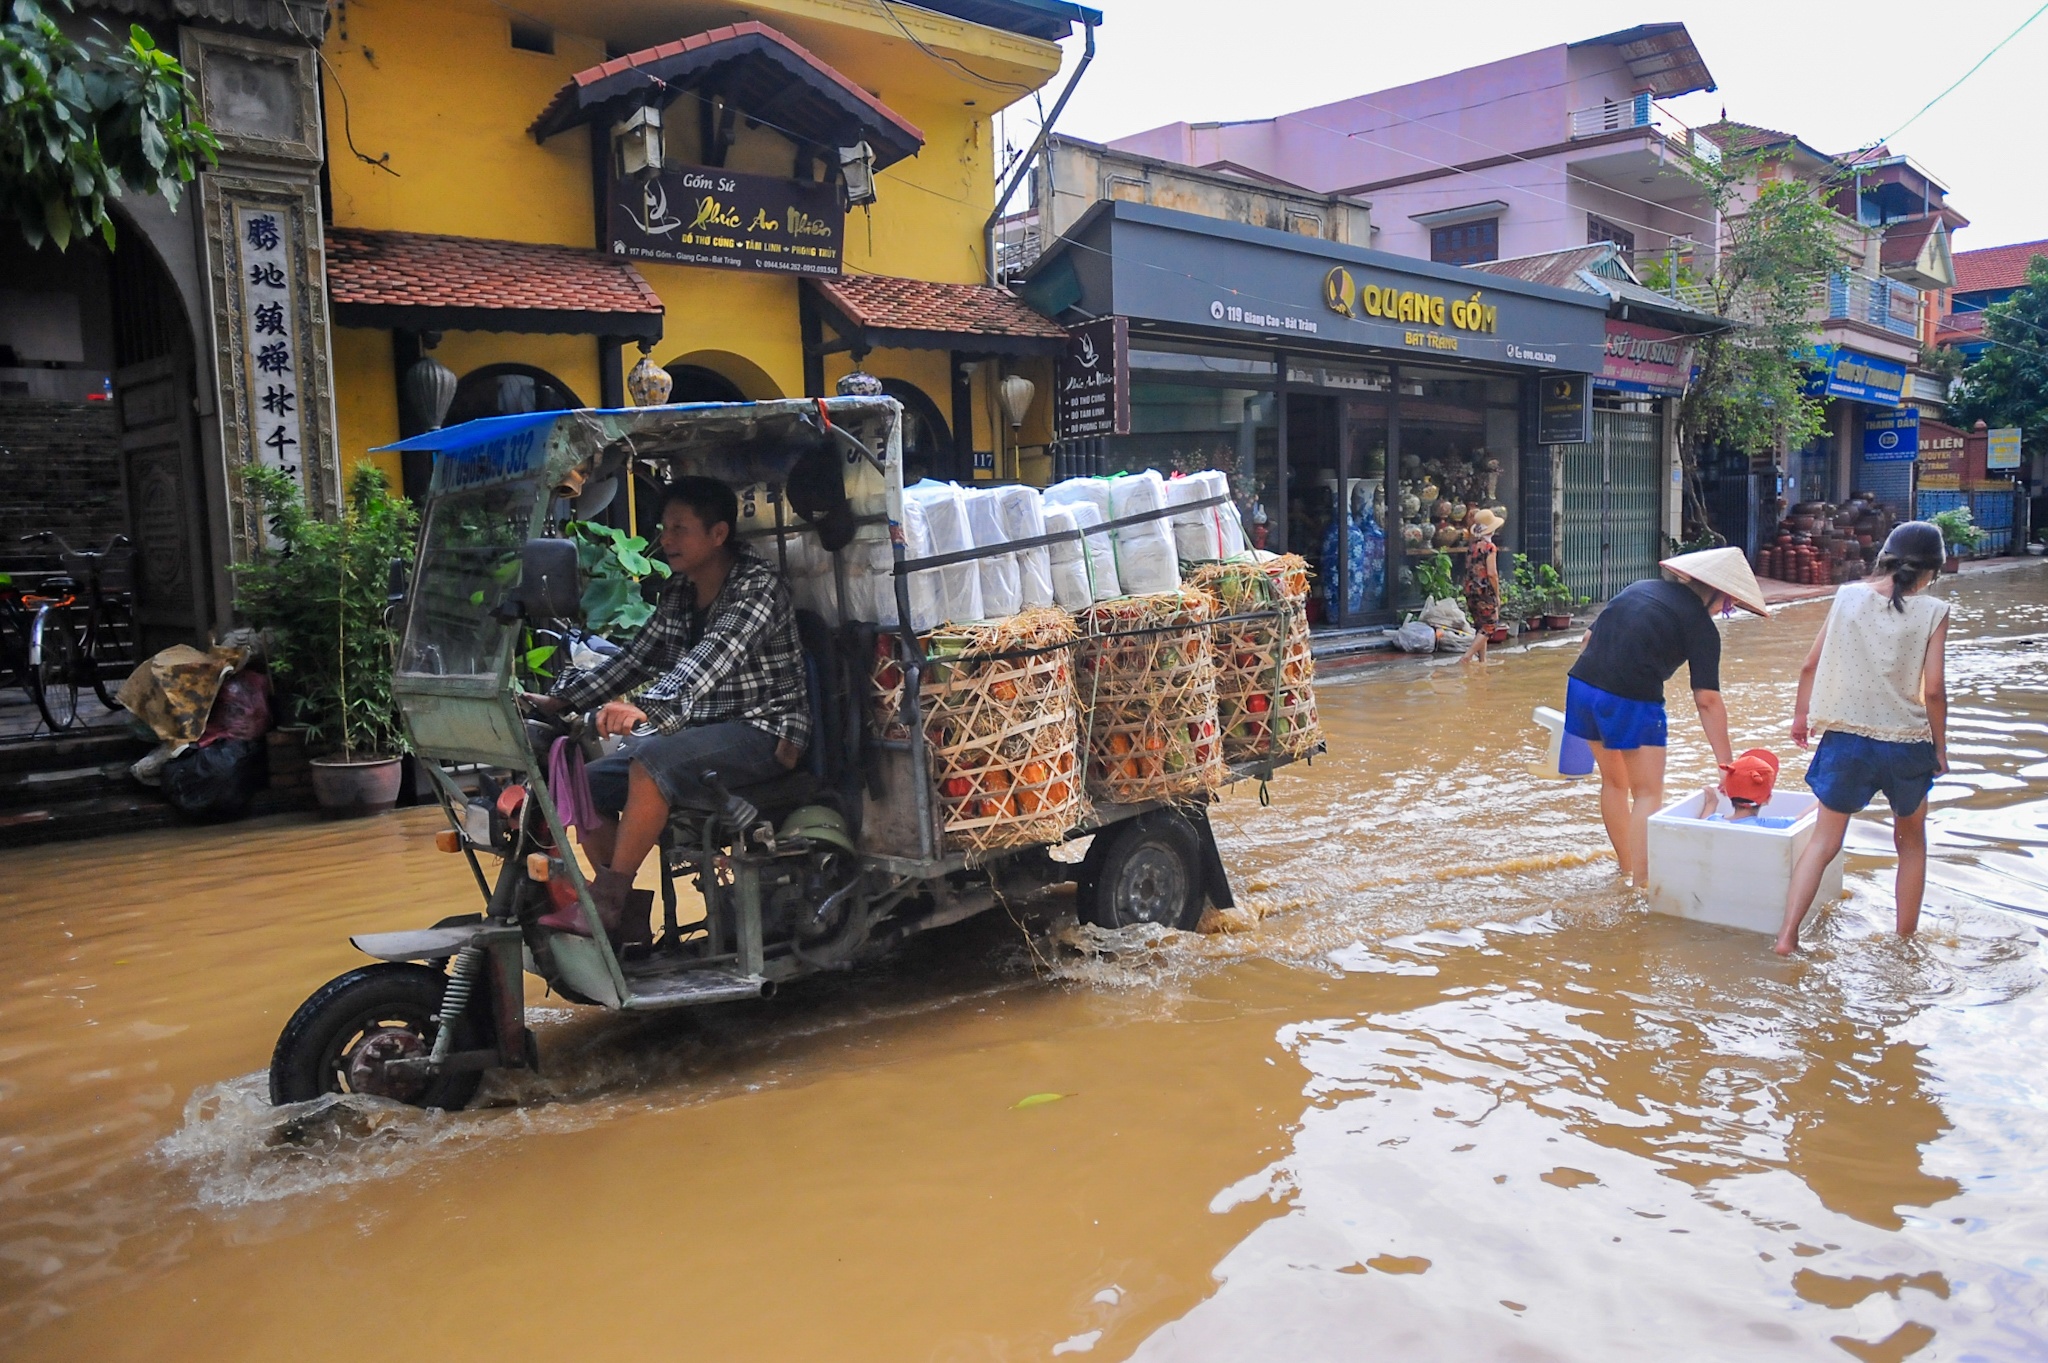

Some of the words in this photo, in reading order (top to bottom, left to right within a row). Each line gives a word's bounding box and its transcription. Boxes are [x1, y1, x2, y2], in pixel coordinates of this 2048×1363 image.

[683, 174, 713, 190] Gốm
[717, 178, 736, 193] Sứ
[629, 247, 639, 256] 117
[676, 252, 694, 262] Giang
[696, 254, 708, 263] Cao
[763, 244, 782, 253] LINH
[1227, 306, 1242, 322] 119
[1244, 311, 1265, 327] Giang
[1266, 314, 1280, 327] Cao
[1364, 284, 1445, 327] QUANG
[1451, 290, 1497, 334] GỐM
[1649, 343, 1678, 366] SINH
[1919, 440, 1929, 450] N
[1932, 437, 1964, 450] LIÊN
[974, 453, 993, 467] 117
